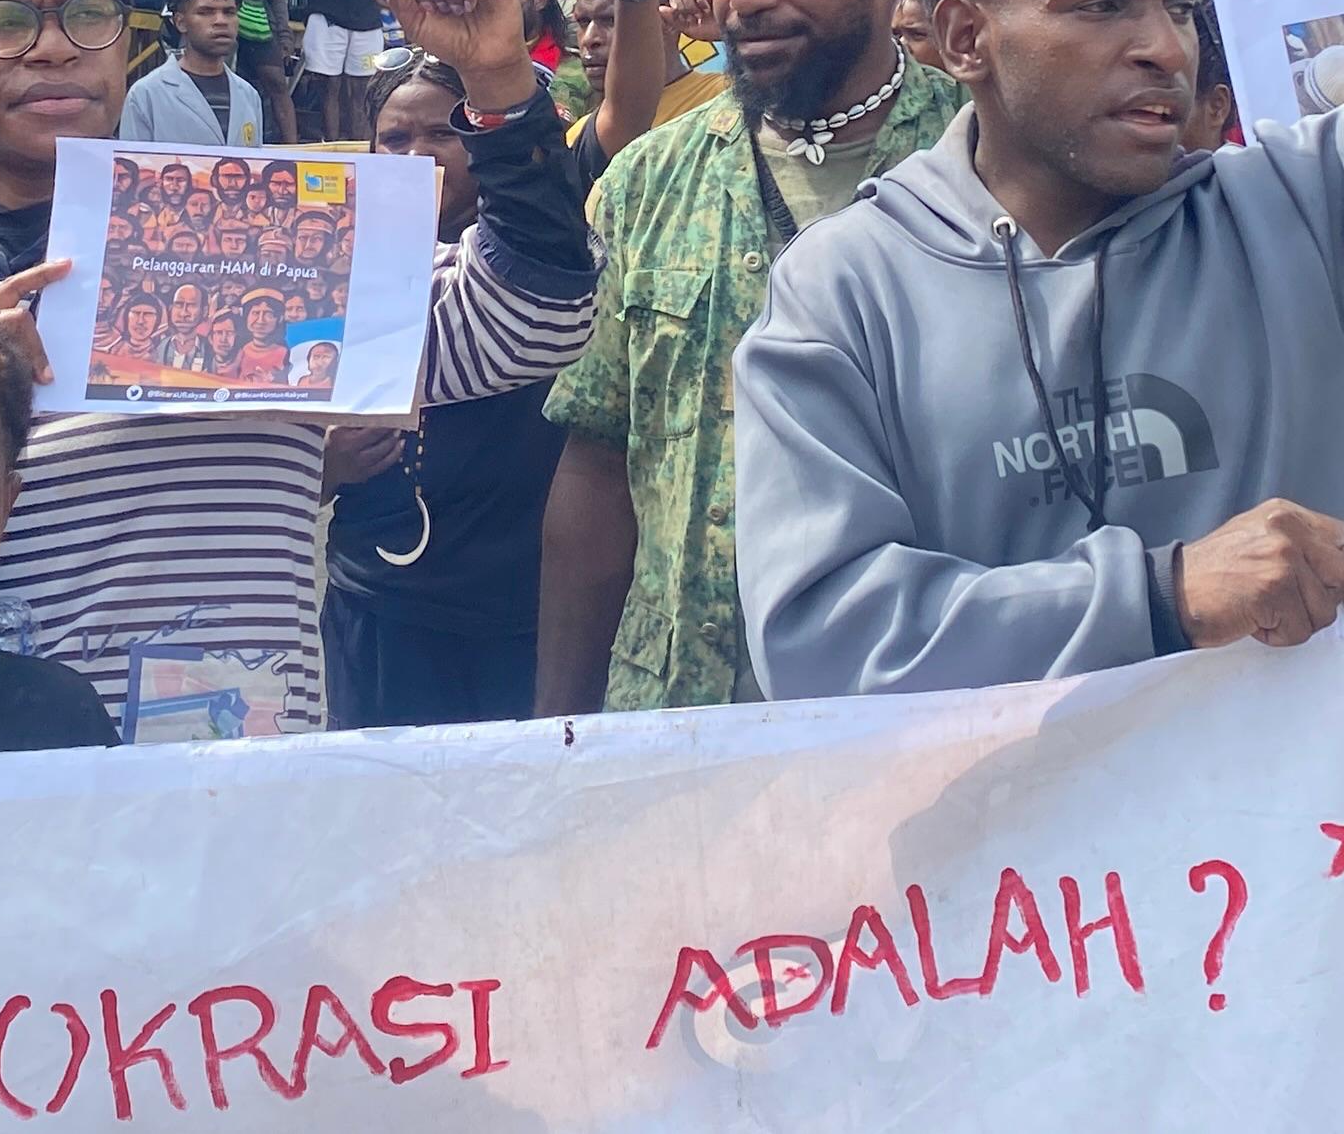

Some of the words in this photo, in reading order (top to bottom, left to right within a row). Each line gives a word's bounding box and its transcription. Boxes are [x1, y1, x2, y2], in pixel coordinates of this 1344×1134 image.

[132, 256, 215, 277] Pelanggaran
[219, 261, 255, 275] HAM
[259, 263, 272, 277] di
[276, 262, 319, 282] Papua
[1052, 378, 1128, 426] THE
[992, 411, 1137, 478] NORTH
[1042, 449, 1144, 506] FACE
[645, 867, 1144, 1050] ADALAH
[1188, 858, 1250, 1012] ?
